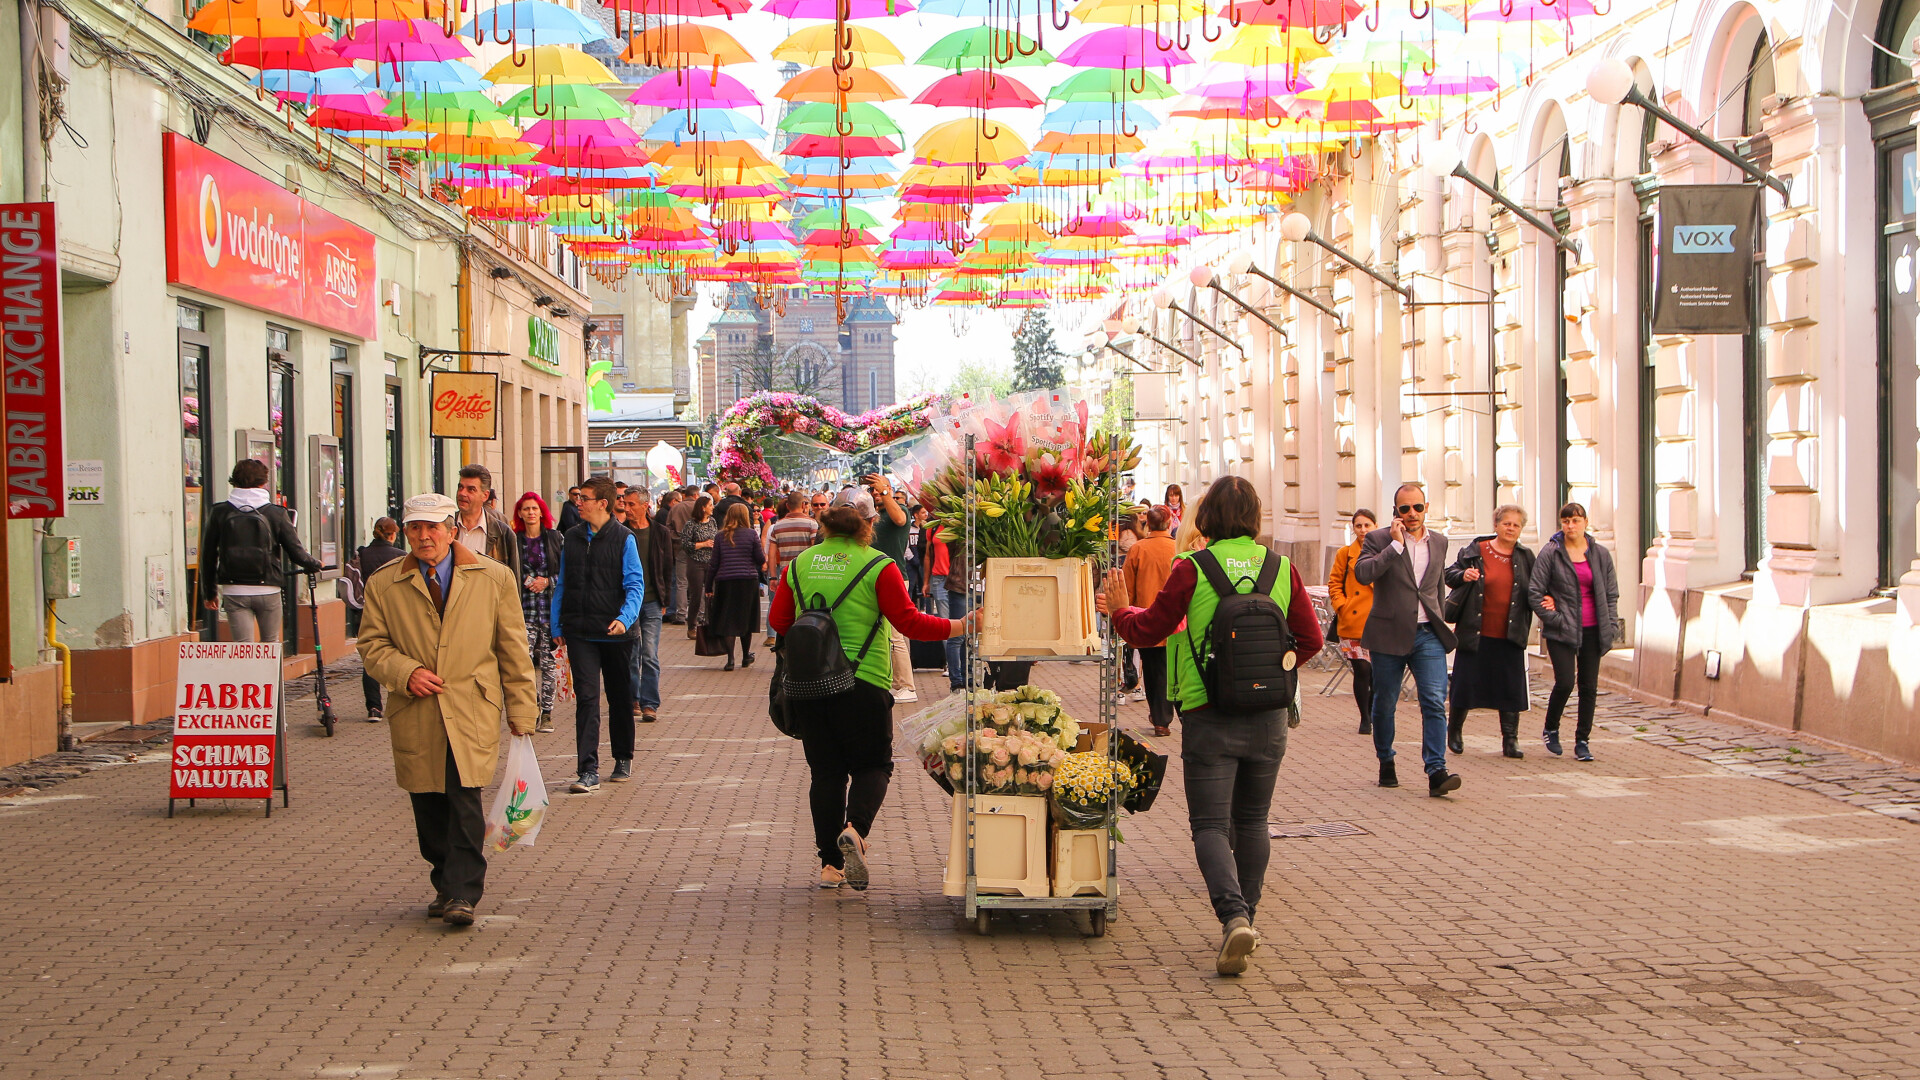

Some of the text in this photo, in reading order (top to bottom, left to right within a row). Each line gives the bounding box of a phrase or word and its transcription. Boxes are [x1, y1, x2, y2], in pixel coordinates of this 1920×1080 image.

[227, 206, 299, 280] vodafone
[1678, 231, 1725, 247] VOX
[1, 210, 57, 511] JABRI EXCHANGE
[434, 389, 492, 420] Optic
[456, 410, 484, 421] shop
[1031, 435, 1056, 451] Spotify
[812, 554, 834, 562] Flori
[1226, 558, 1251, 568] Flori
[810, 561, 847, 572] Holland
[1227, 567, 1261, 578] Hollan
[196, 644, 227, 659] SHARIF
[228, 644, 254, 659] JABRI
[255, 644, 276, 659] S.R.L
[179, 683, 274, 710] JABRI
[178, 714, 273, 729] EXCHANGE
[174, 744, 271, 767] SCHIMB
[174, 769, 269, 788] VALUTAR
